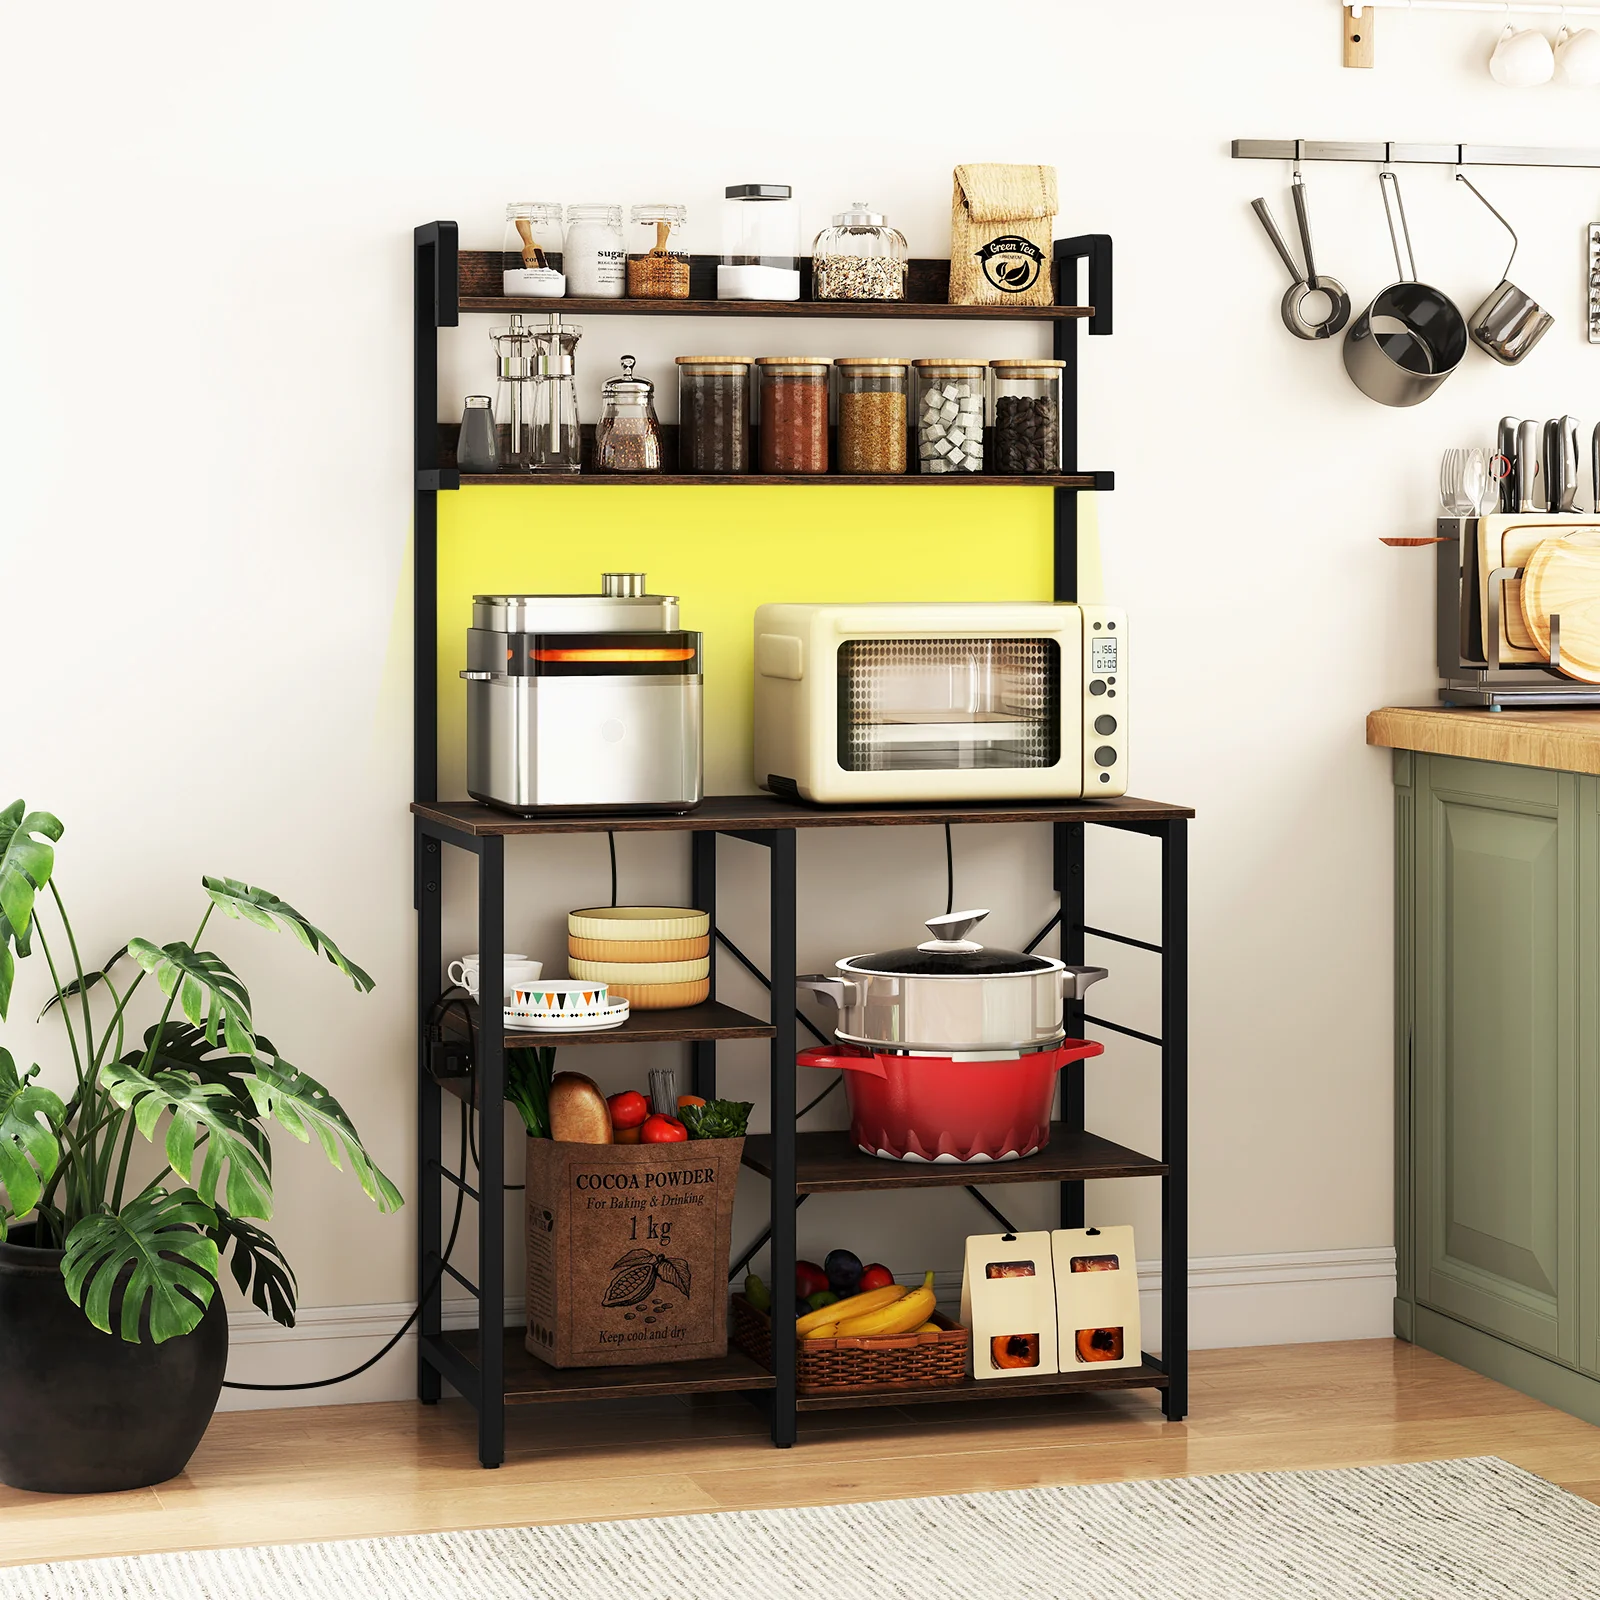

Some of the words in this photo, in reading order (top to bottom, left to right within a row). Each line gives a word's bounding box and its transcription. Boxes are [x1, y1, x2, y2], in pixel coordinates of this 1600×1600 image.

[597, 250, 624, 260] sugar
[653, 250, 684, 260] sugar
[990, 243, 1017, 253] Green
[1019, 242, 1036, 256] Tea
[576, 1174, 640, 1190] COCOA
[645, 1168, 715, 1189] POWDER
[586, 1197, 607, 1209] For
[609, 1197, 648, 1211] Baking
[649, 1195, 659, 1207] &
[661, 1192, 705, 1207] Drinking
[629, 1215, 638, 1240] 1
[646, 1215, 673, 1246] kg
[599, 1330, 625, 1346] Keep
[627, 1327, 648, 1341] cool
[649, 1326, 669, 1340] and
[670, 1325, 687, 1341] dry
